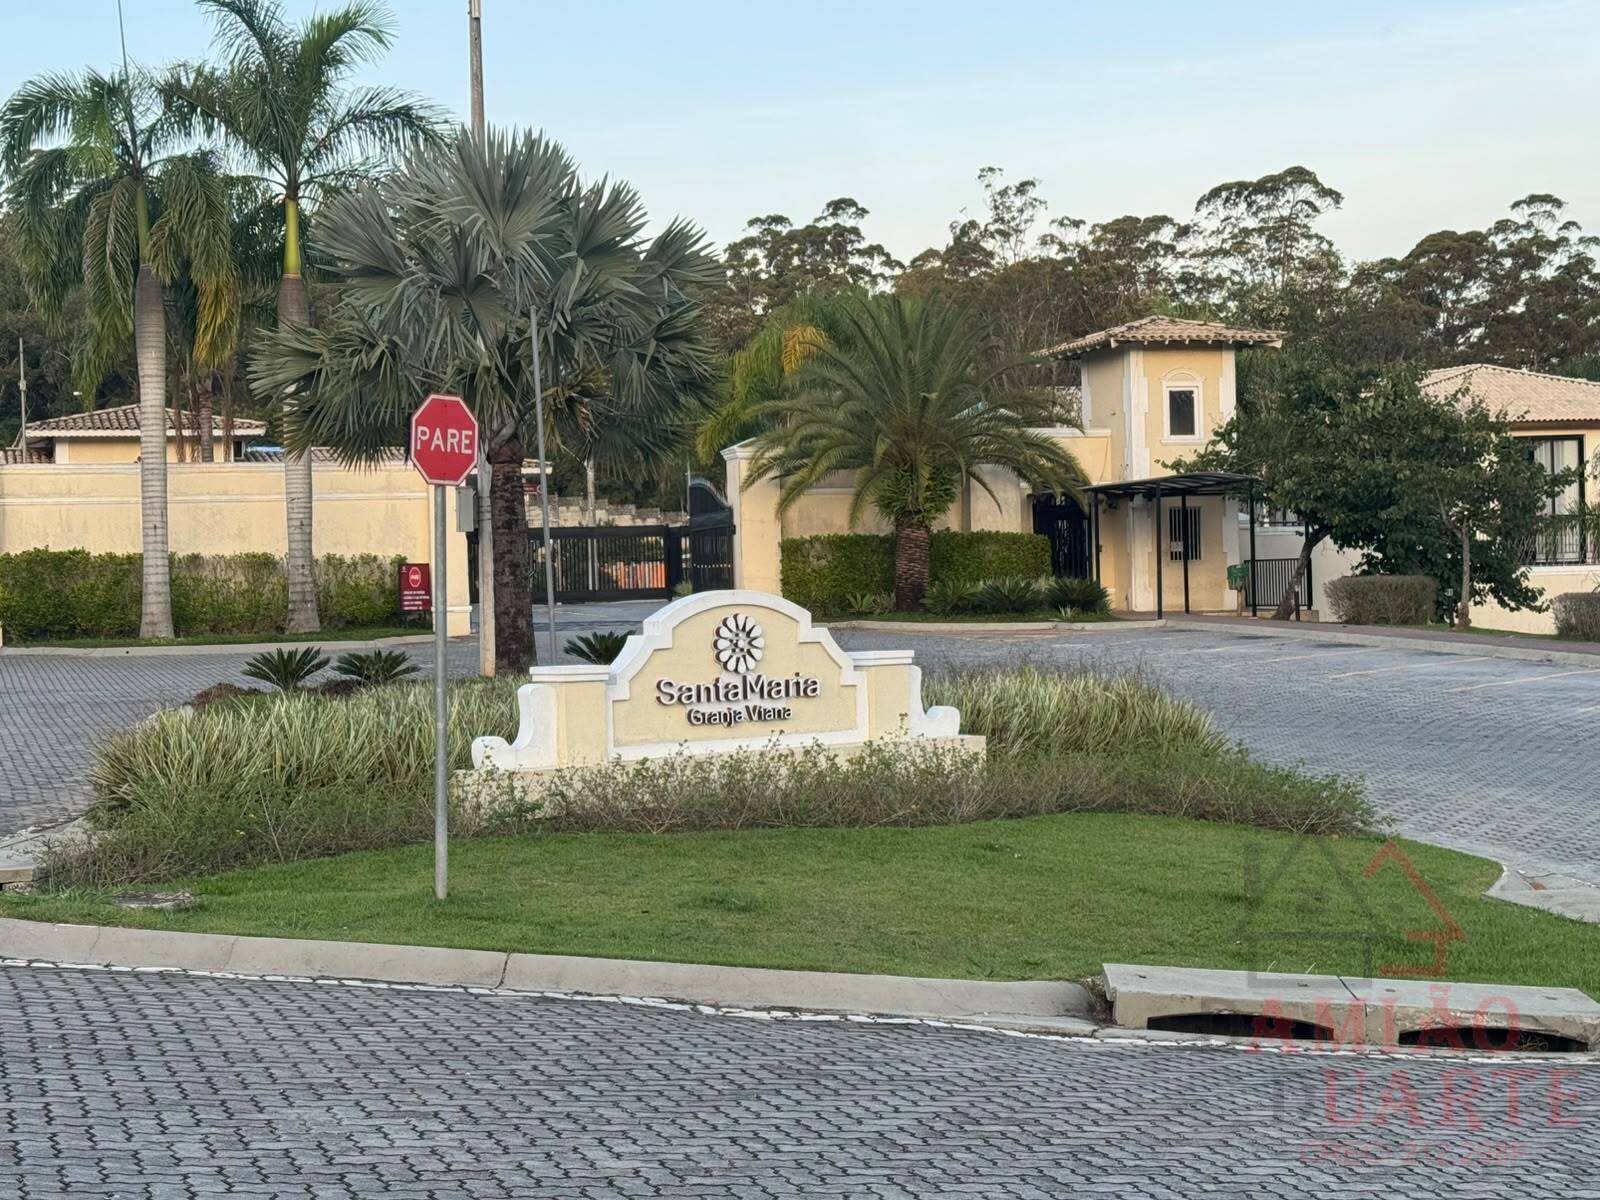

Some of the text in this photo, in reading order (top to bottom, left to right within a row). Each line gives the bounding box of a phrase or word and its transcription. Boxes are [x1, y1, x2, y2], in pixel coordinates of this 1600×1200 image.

[416, 425, 473, 454] PARE
[687, 704, 793, 727] Granja Viana
